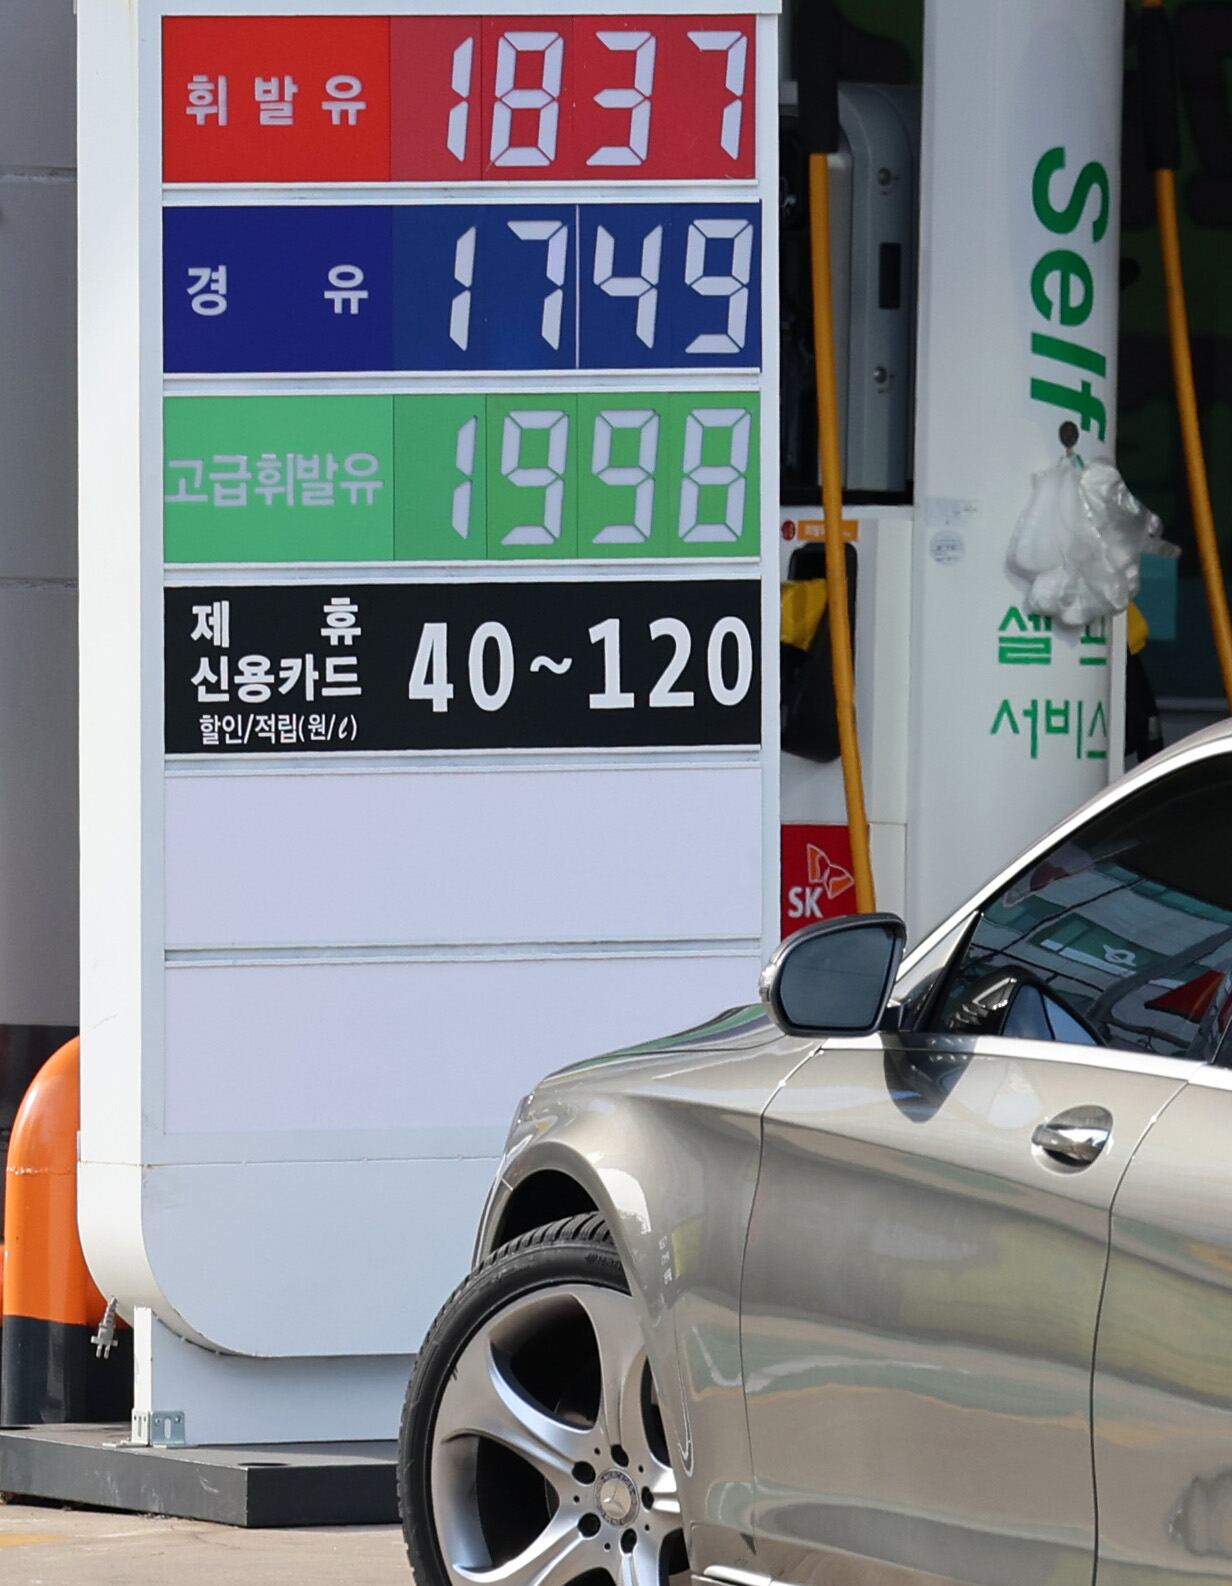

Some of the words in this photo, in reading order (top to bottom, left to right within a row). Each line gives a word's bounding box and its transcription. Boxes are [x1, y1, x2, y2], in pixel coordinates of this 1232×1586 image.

[185, 75, 367, 126] 휘발유
[447, 31, 748, 167] 1837
[449, 219, 753, 354] 1749
[1029, 146, 1110, 442] Self
[165, 452, 383, 507] 고급휘발유
[452, 409, 751, 545] 1998
[190, 653, 362, 703] 신용카드
[990, 698, 1107, 760] 서비스
[787, 886, 824, 919] SK
